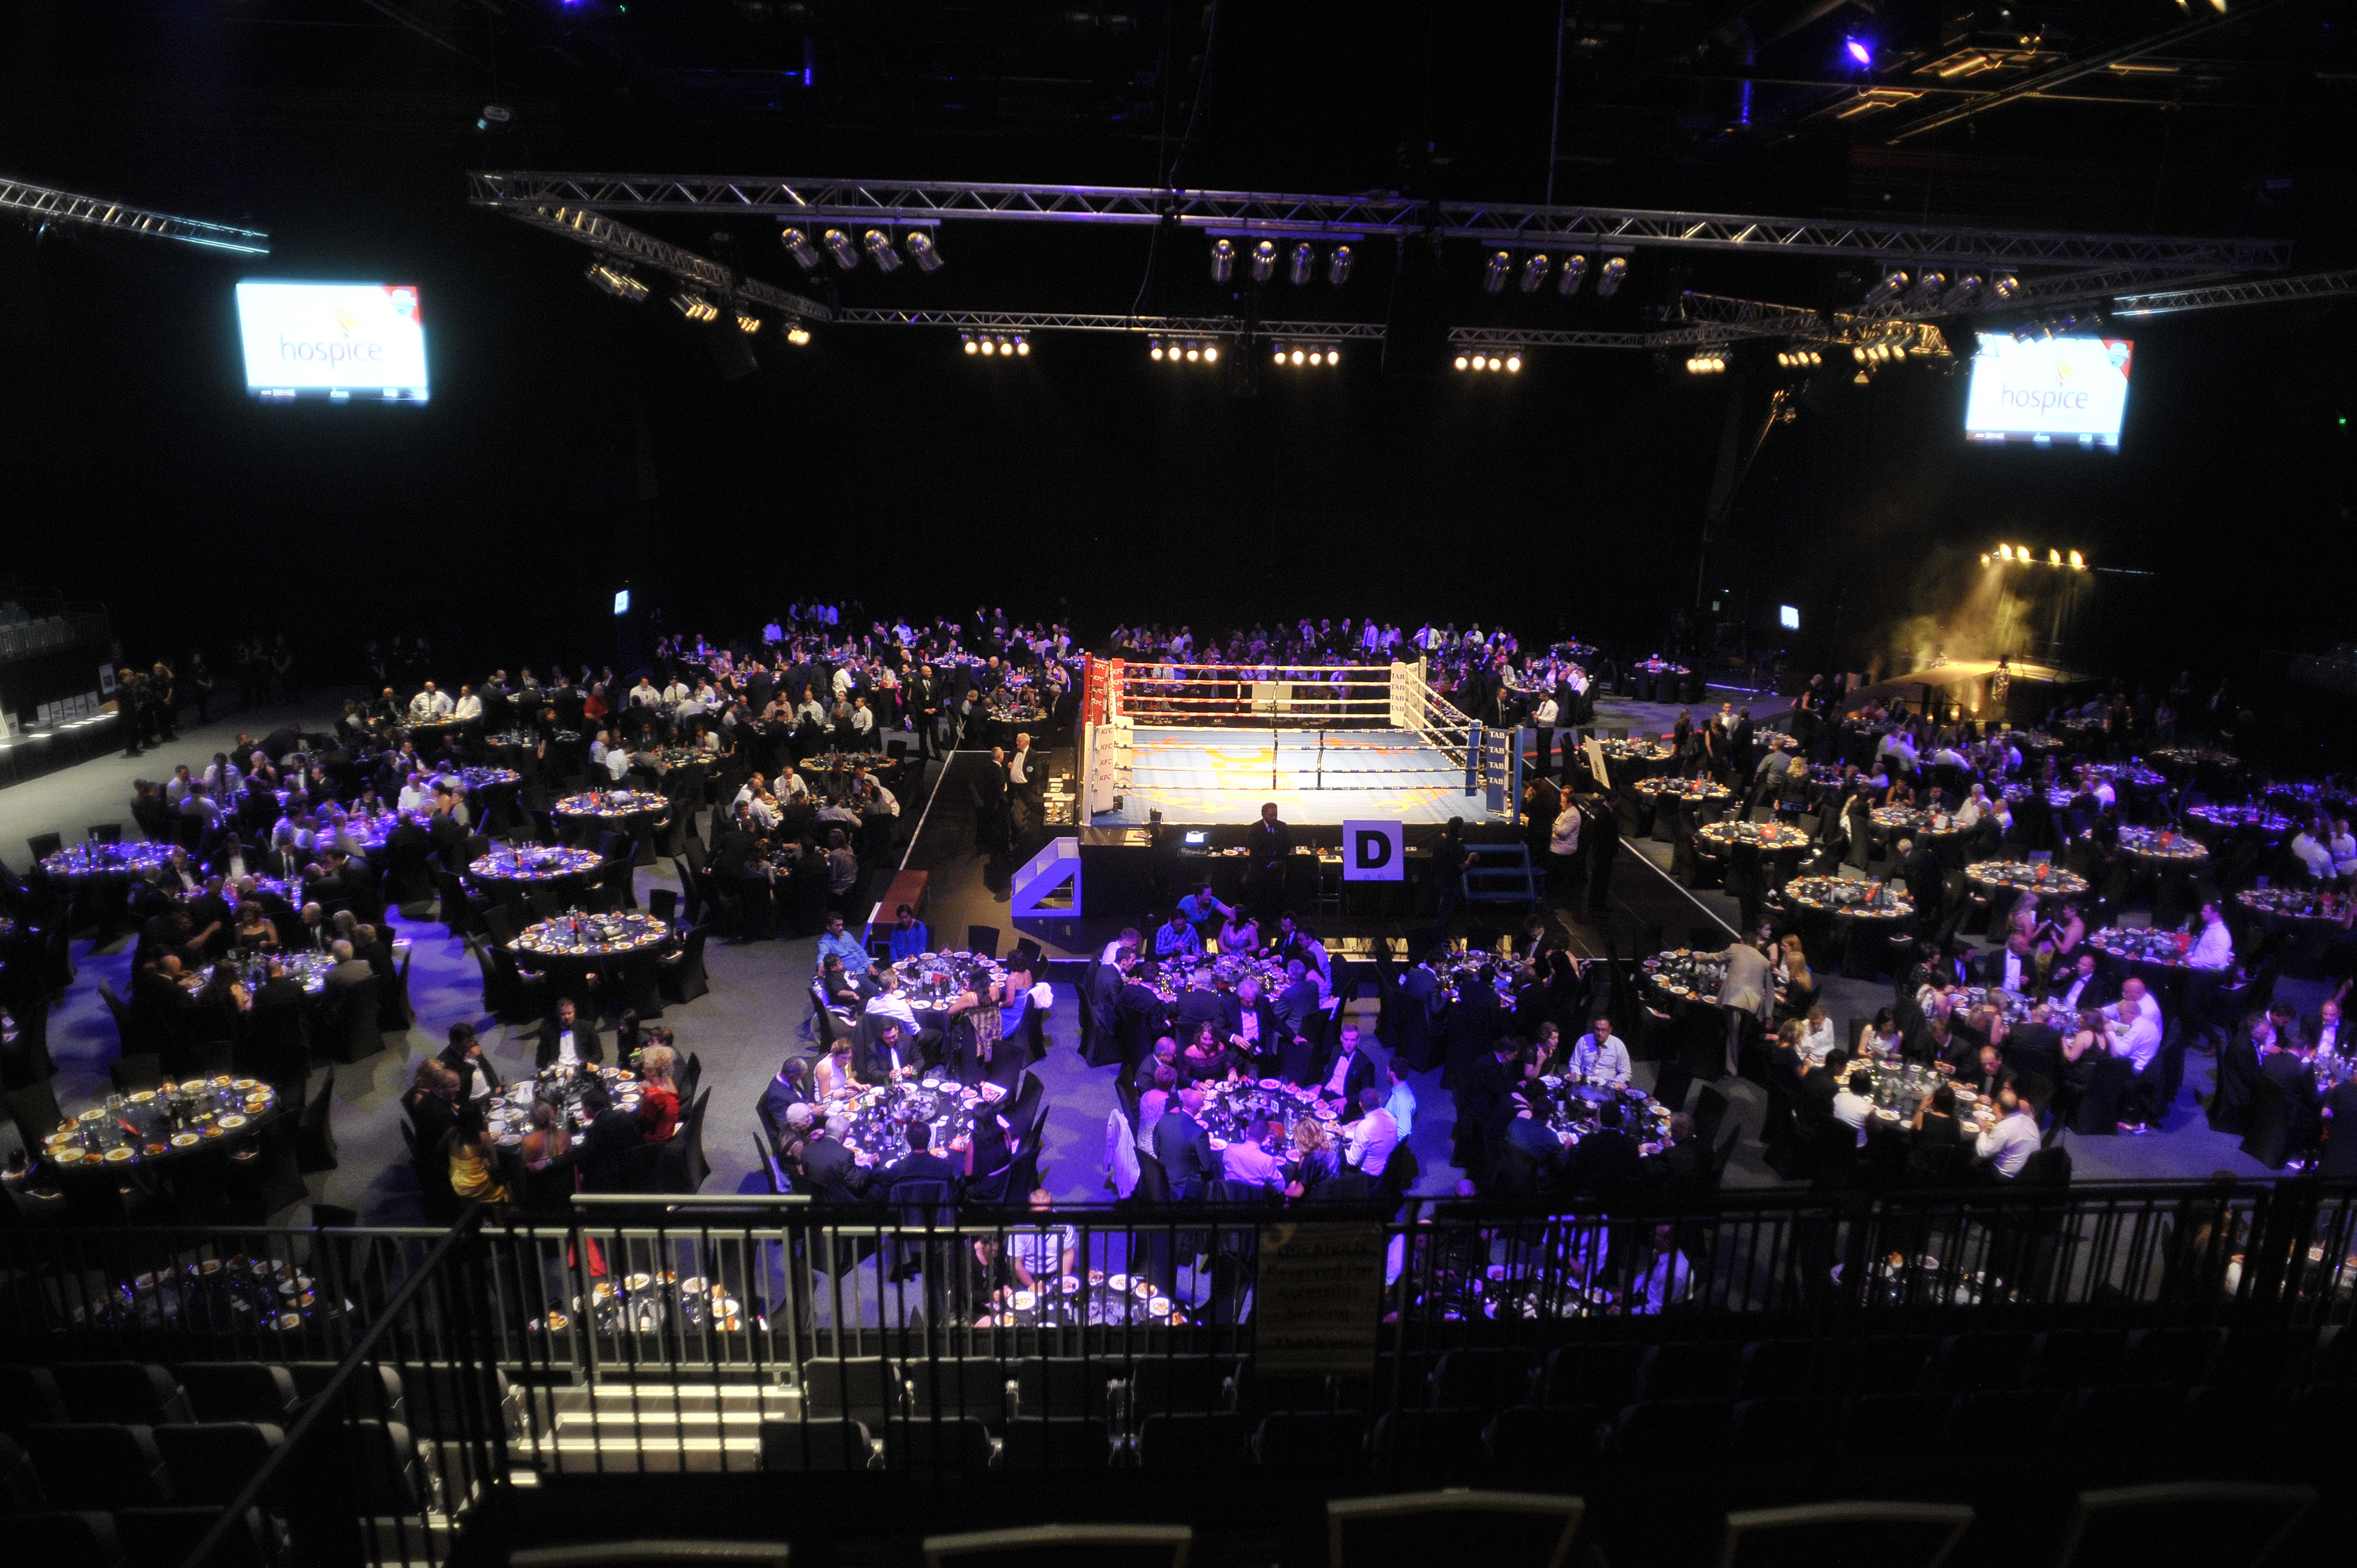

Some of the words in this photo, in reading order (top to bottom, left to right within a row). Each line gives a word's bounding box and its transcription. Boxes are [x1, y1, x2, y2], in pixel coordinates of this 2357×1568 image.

[279, 333, 382, 369] hospice
[2001, 382, 2089, 415] hospice
[1356, 830, 1392, 869] D
